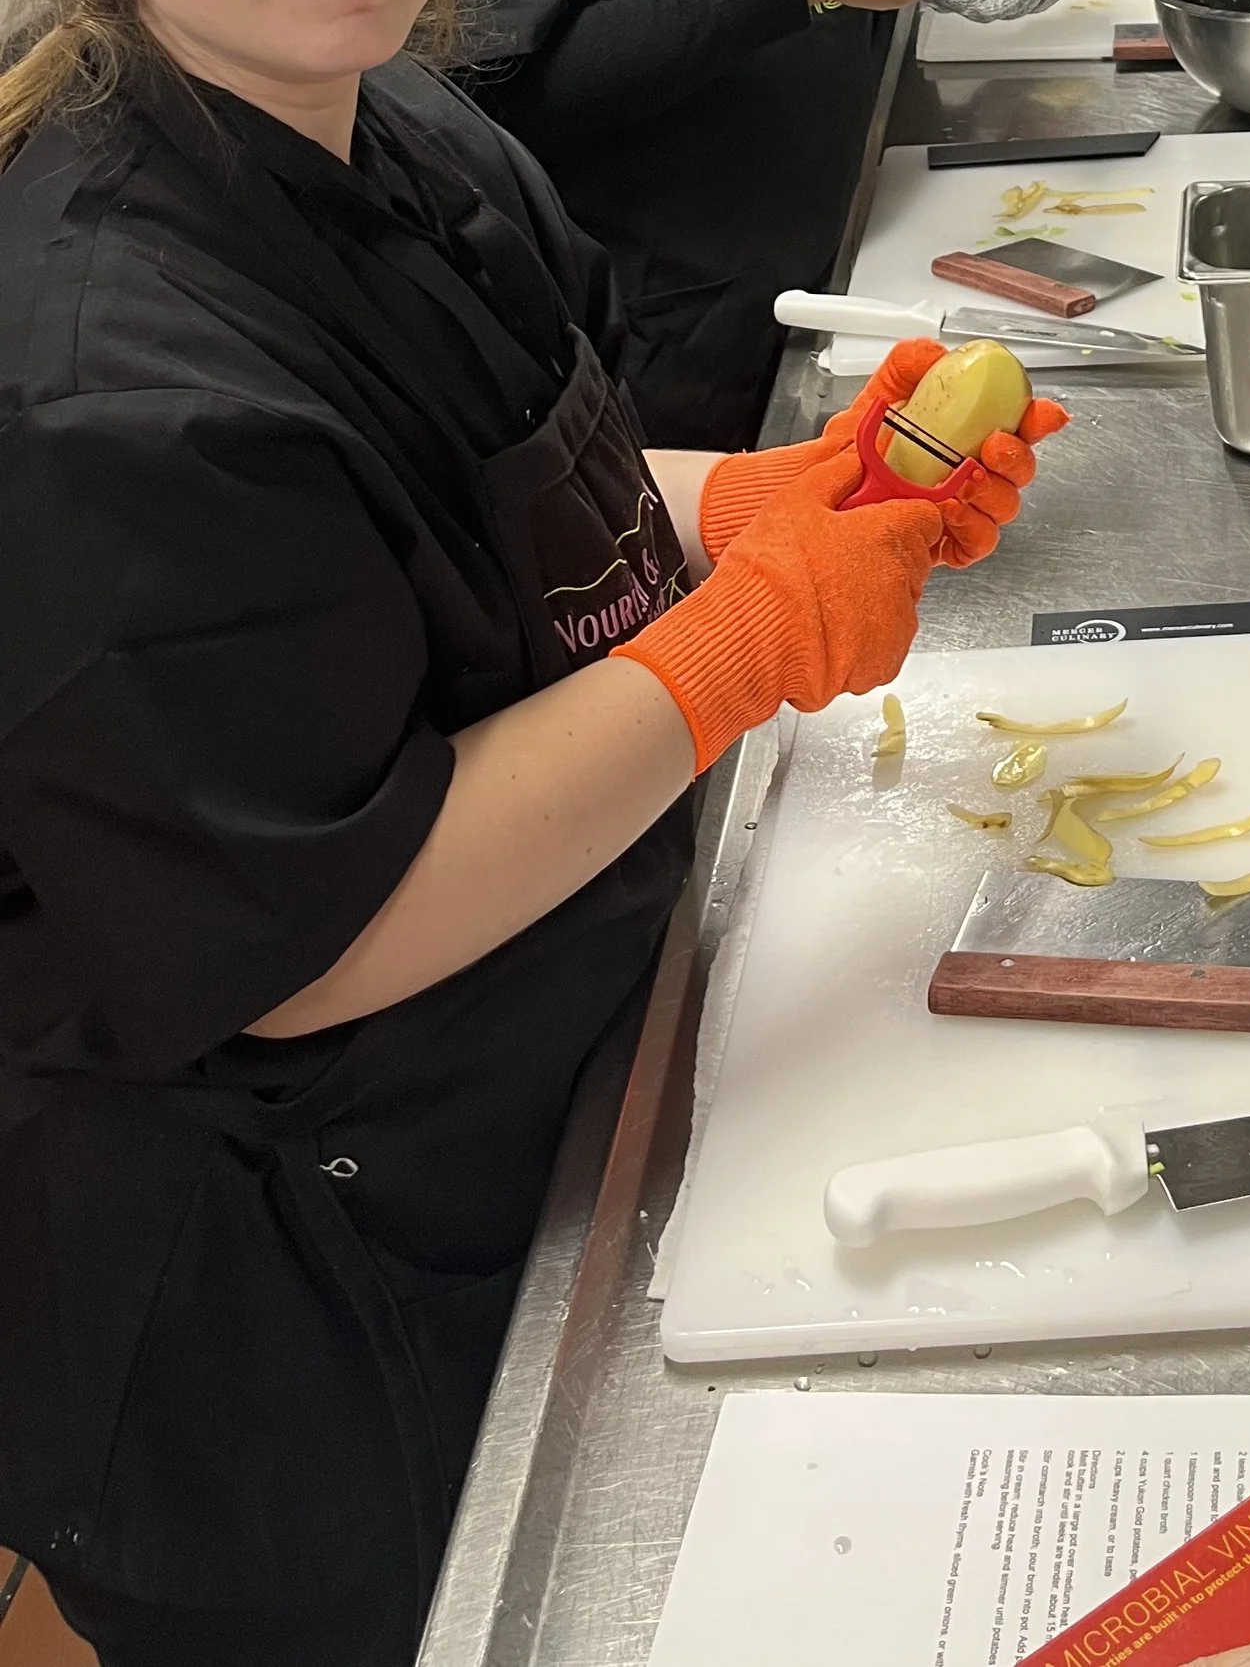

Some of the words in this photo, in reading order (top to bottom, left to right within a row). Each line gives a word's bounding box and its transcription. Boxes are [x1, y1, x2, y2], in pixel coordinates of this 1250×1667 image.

[1052, 627, 1103, 635] MERCER
[967, 1448, 980, 1480] Garnish
[978, 1448, 993, 1476] Cook's
[1018, 1449, 1029, 1463] Stir
[1043, 1449, 1053, 1464] Stir
[1066, 1449, 1075, 1469] cook
[1078, 1449, 1089, 1467] Melt
[1213, 1450, 1222, 1465] salt
[999, 1449, 1015, 1490] seasoning
[1017, 1464, 1024, 1473] in
[1087, 1449, 1102, 1490] Directions
[1113, 1457, 1123, 1477] cups
[1138, 1457, 1148, 1477] cups
[1163, 1457, 1172, 1479] quart
[1212, 1467, 1221, 1483] and
[975, 1477, 988, 1498] Note
[1036, 1464, 1049, 1507] cornstarch
[1063, 1470, 1073, 1486] and
[1075, 1468, 1086, 1492] butter
[1186, 1457, 1197, 1502] tablespoon
[963, 1481, 972, 1499] with
[1062, 1487, 1071, 1501] stir
[1074, 1493, 1082, 1501] in
[1109, 1478, 1122, 1503] heavy
[1136, 1478, 1148, 1505] Yukon
[1160, 1479, 1171, 1511] chicken
[1210, 1483, 1220, 1513] pepper
[960, 1499, 972, 1521] fresh
[997, 1491, 1010, 1518] before
[1059, 1501, 1069, 1519] until
[1007, 1503, 1019, 1532] reduce
[1033, 1508, 1043, 1524] into
[1069, 1510, 1081, 1532] large
[1133, 1505, 1145, 1526] Gold
[1159, 1512, 1169, 1534] broth
[1056, 1520, 1067, 1543] leeks
[1068, 1532, 1078, 1547] pot
[1107, 1533, 1116, 1544] or
[1004, 1533, 1016, 1553] heat
[1054, 1544, 1064, 1560] are
[1105, 1544, 1116, 1554] to
[1129, 1527, 1142, 1567] potatoes,
[949, 1552, 962, 1577] sliced
[1001, 1554, 1012, 1571] and
[1027, 1551, 1038, 1572] pour
[1066, 1548, 1076, 1568] over
[1103, 1555, 1115, 1577] taste
[945, 1578, 957, 1605] green
[997, 1572, 1009, 1605] simmer
[1024, 1573, 1036, 1597] broth
[1062, 1569, 1074, 1605] medium
[994, 1606, 1004, 1626] until
[1021, 1598, 1031, 1615] into
[1047, 1593, 1059, 1619] about
[1132, 1631, 1153, 1650] are
[1150, 1610, 1179, 1635] built
[1176, 1601, 1193, 1615] in
[1190, 1592, 1205, 1605] to
[1204, 1562, 1245, 1597] protect
[1045, 1621, 1056, 1633] 15
[938, 1639, 947, 1650] or
[987, 1626, 1001, 1666] potatoes
[1016, 1634, 1028, 1654] Add
